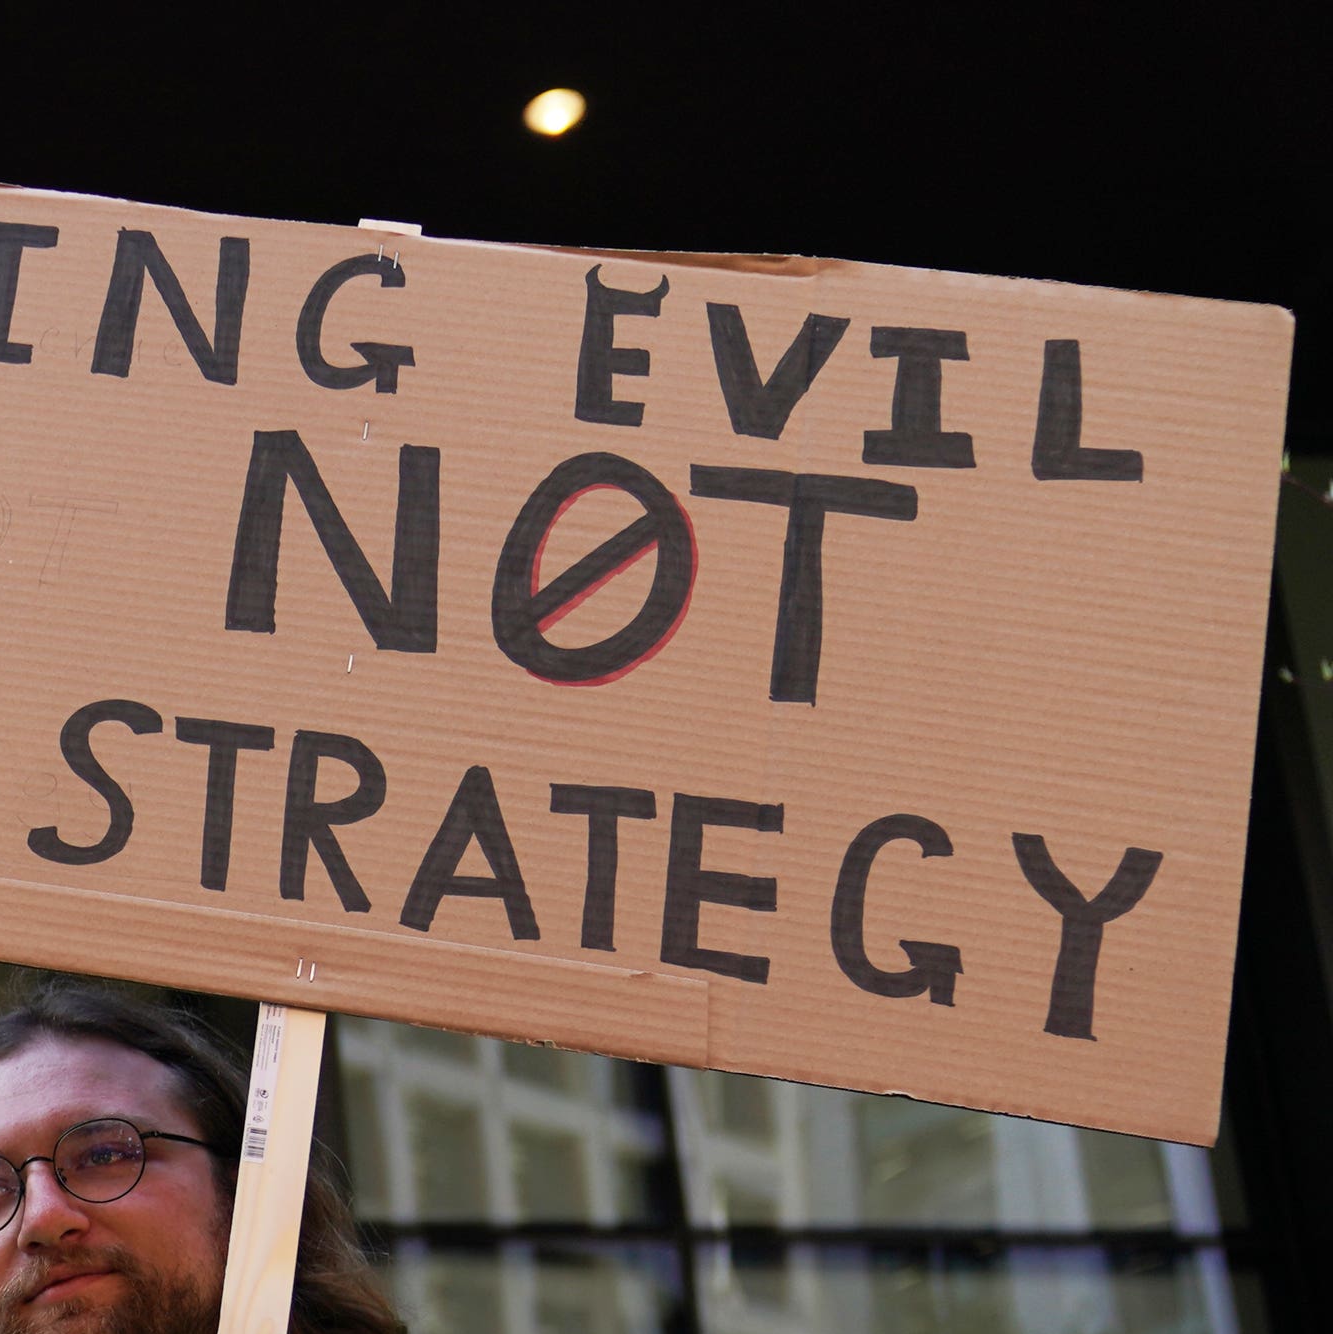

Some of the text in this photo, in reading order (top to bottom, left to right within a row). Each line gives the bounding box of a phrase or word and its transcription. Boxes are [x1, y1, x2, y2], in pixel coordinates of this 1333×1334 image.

[574, 264, 1144, 483] EVIL
[225, 430, 918, 708] NOT
[27, 699, 1164, 1042] STRATEGY
